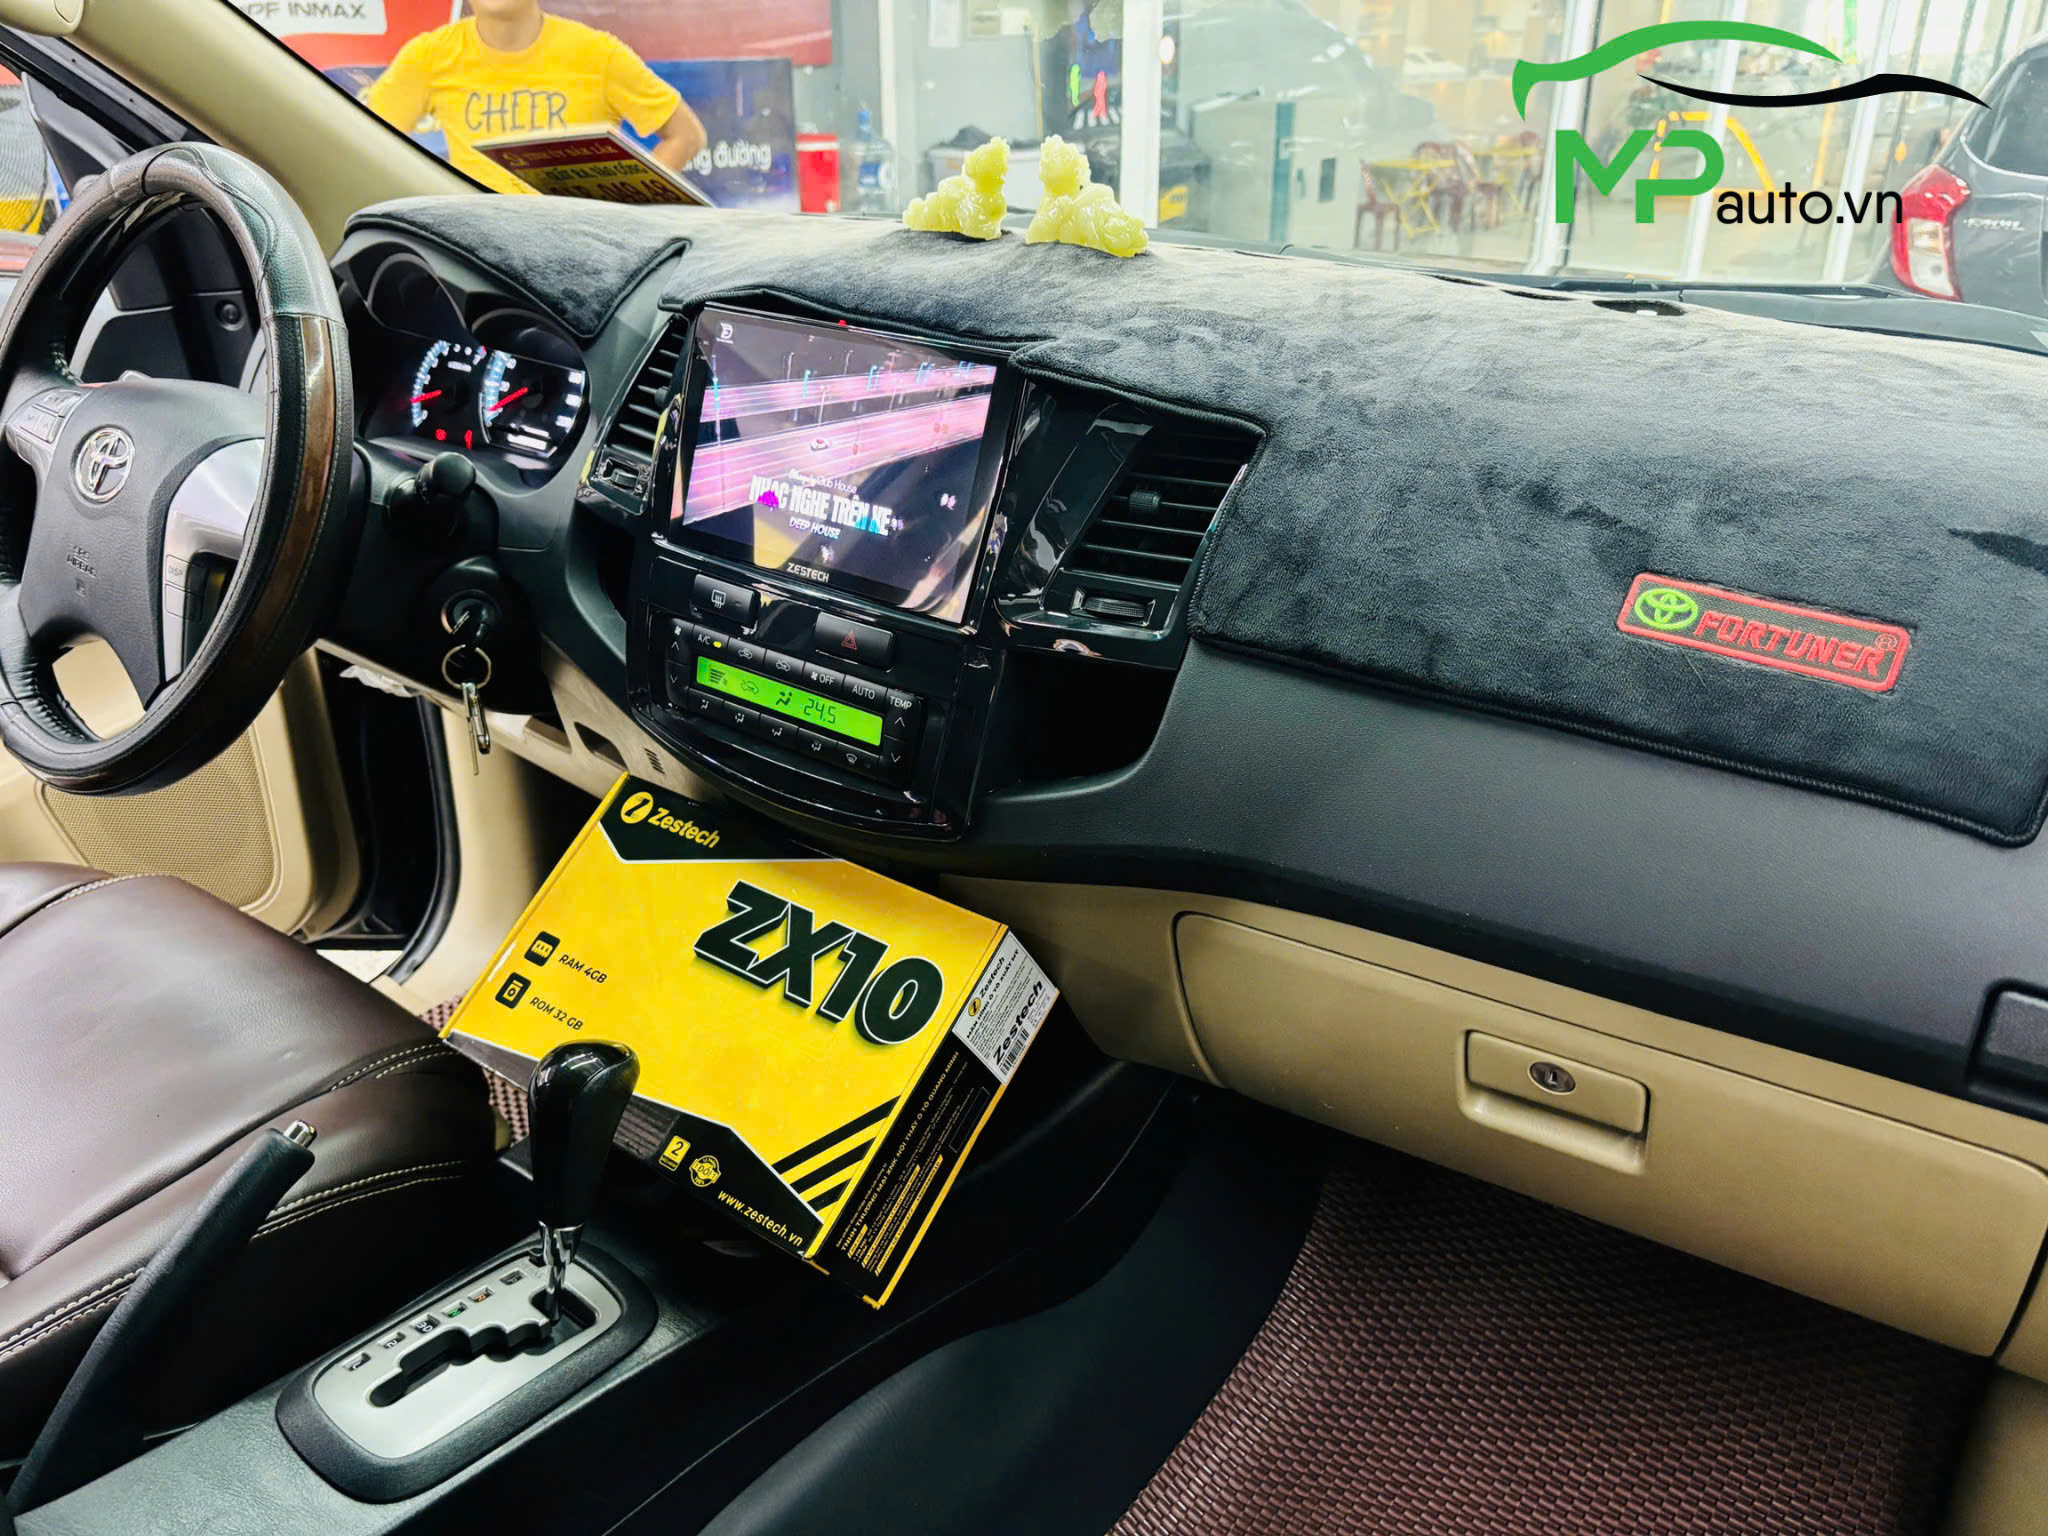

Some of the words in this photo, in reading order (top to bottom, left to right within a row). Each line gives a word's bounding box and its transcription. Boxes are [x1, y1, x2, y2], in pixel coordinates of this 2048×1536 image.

[288, 2, 366, 19] INMAX
[465, 89, 567, 132] CHEER
[713, 138, 771, 172] đường
[790, 486, 830, 520] NGHE
[831, 494, 870, 531] TRÊN
[869, 505, 893, 536] XE
[789, 517, 811, 531] DEEP
[812, 523, 841, 539] HOUSE
[787, 562, 830, 582] ZESTECH
[697, 634, 711, 646] A/C
[819, 673, 835, 686] OFF
[852, 684, 876, 700] AUTO
[803, 697, 837, 725] 24.5
[890, 695, 912, 710] TEMP
[647, 807, 720, 848] Zestech
[559, 954, 584, 972] RAM
[584, 967, 607, 984] 4GB
[694, 880, 944, 1045] ZX10
[530, 997, 555, 1015] ROM
[553, 1009, 568, 1022] 32
[566, 1017, 583, 1030] GB
[992, 980, 1044, 1066] Zestech
[671, 1141, 684, 1157] 2
[717, 1190, 804, 1248] www.zestech.vn
